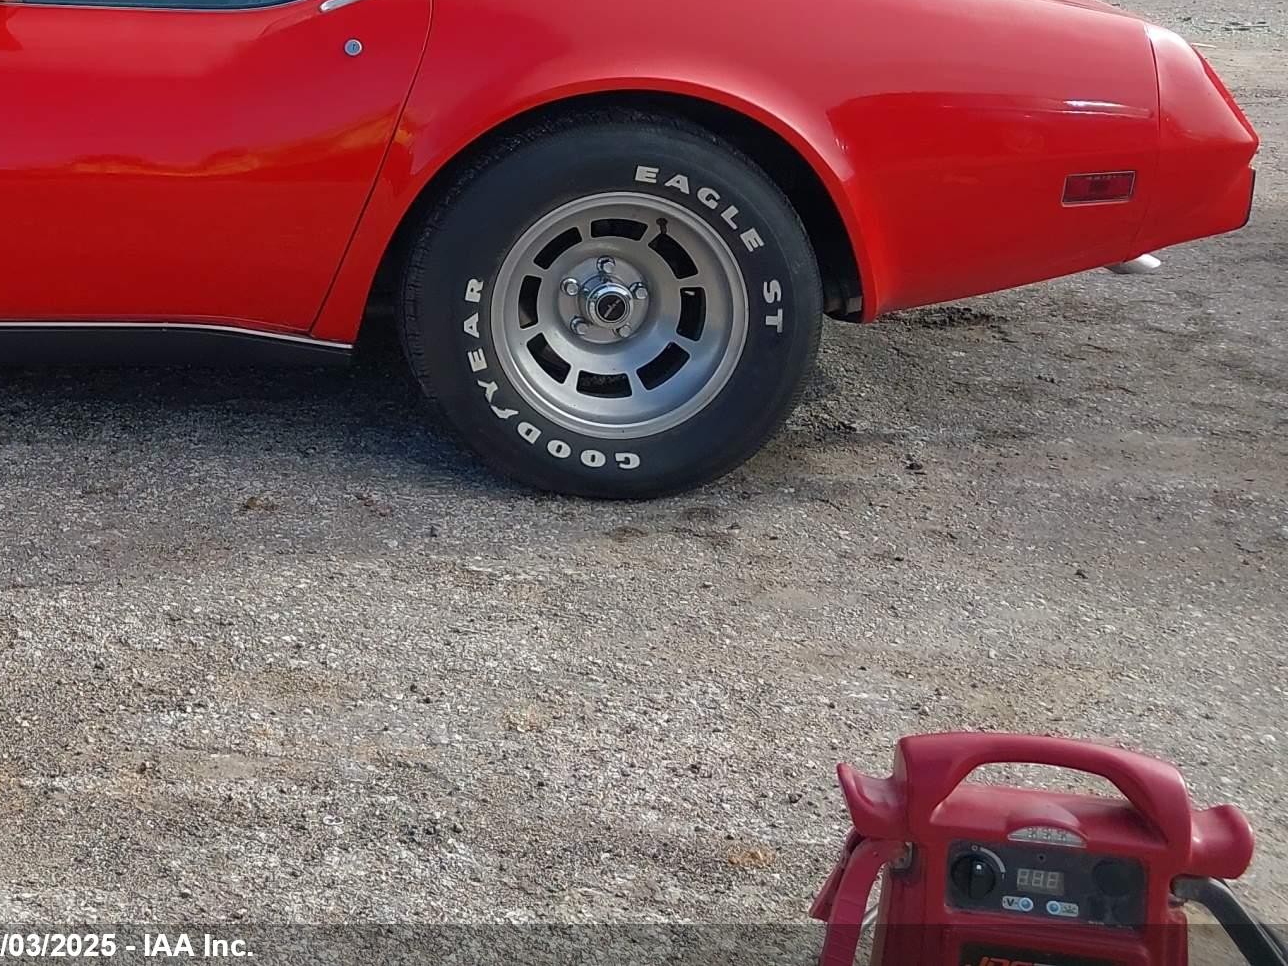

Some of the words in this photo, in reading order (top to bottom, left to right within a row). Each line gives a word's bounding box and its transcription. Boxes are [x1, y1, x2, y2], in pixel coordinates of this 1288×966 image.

[634, 165, 764, 253] EAGLE
[763, 278, 784, 334] ST
[463, 277, 642, 471] GOODYEAR
